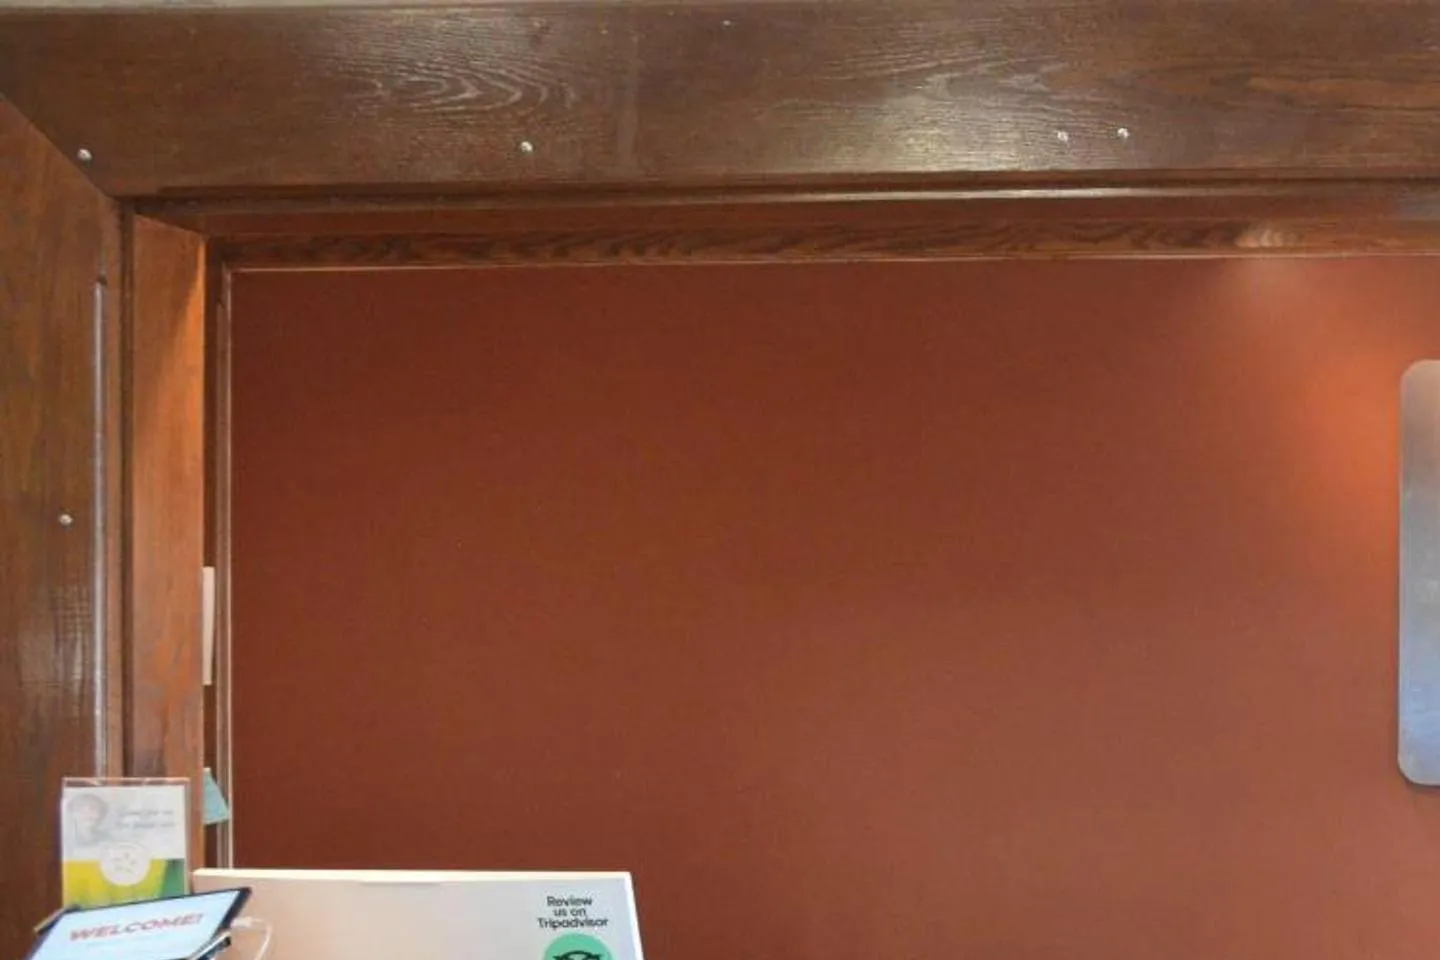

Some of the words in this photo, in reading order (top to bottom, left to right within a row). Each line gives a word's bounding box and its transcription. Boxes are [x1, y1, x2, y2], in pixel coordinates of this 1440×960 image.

[546, 895, 593, 907] Review
[553, 908, 568, 917] us
[570, 908, 587, 917] on
[69, 912, 204, 942] WELCOME!
[538, 917, 609, 930] Tripadvisor
